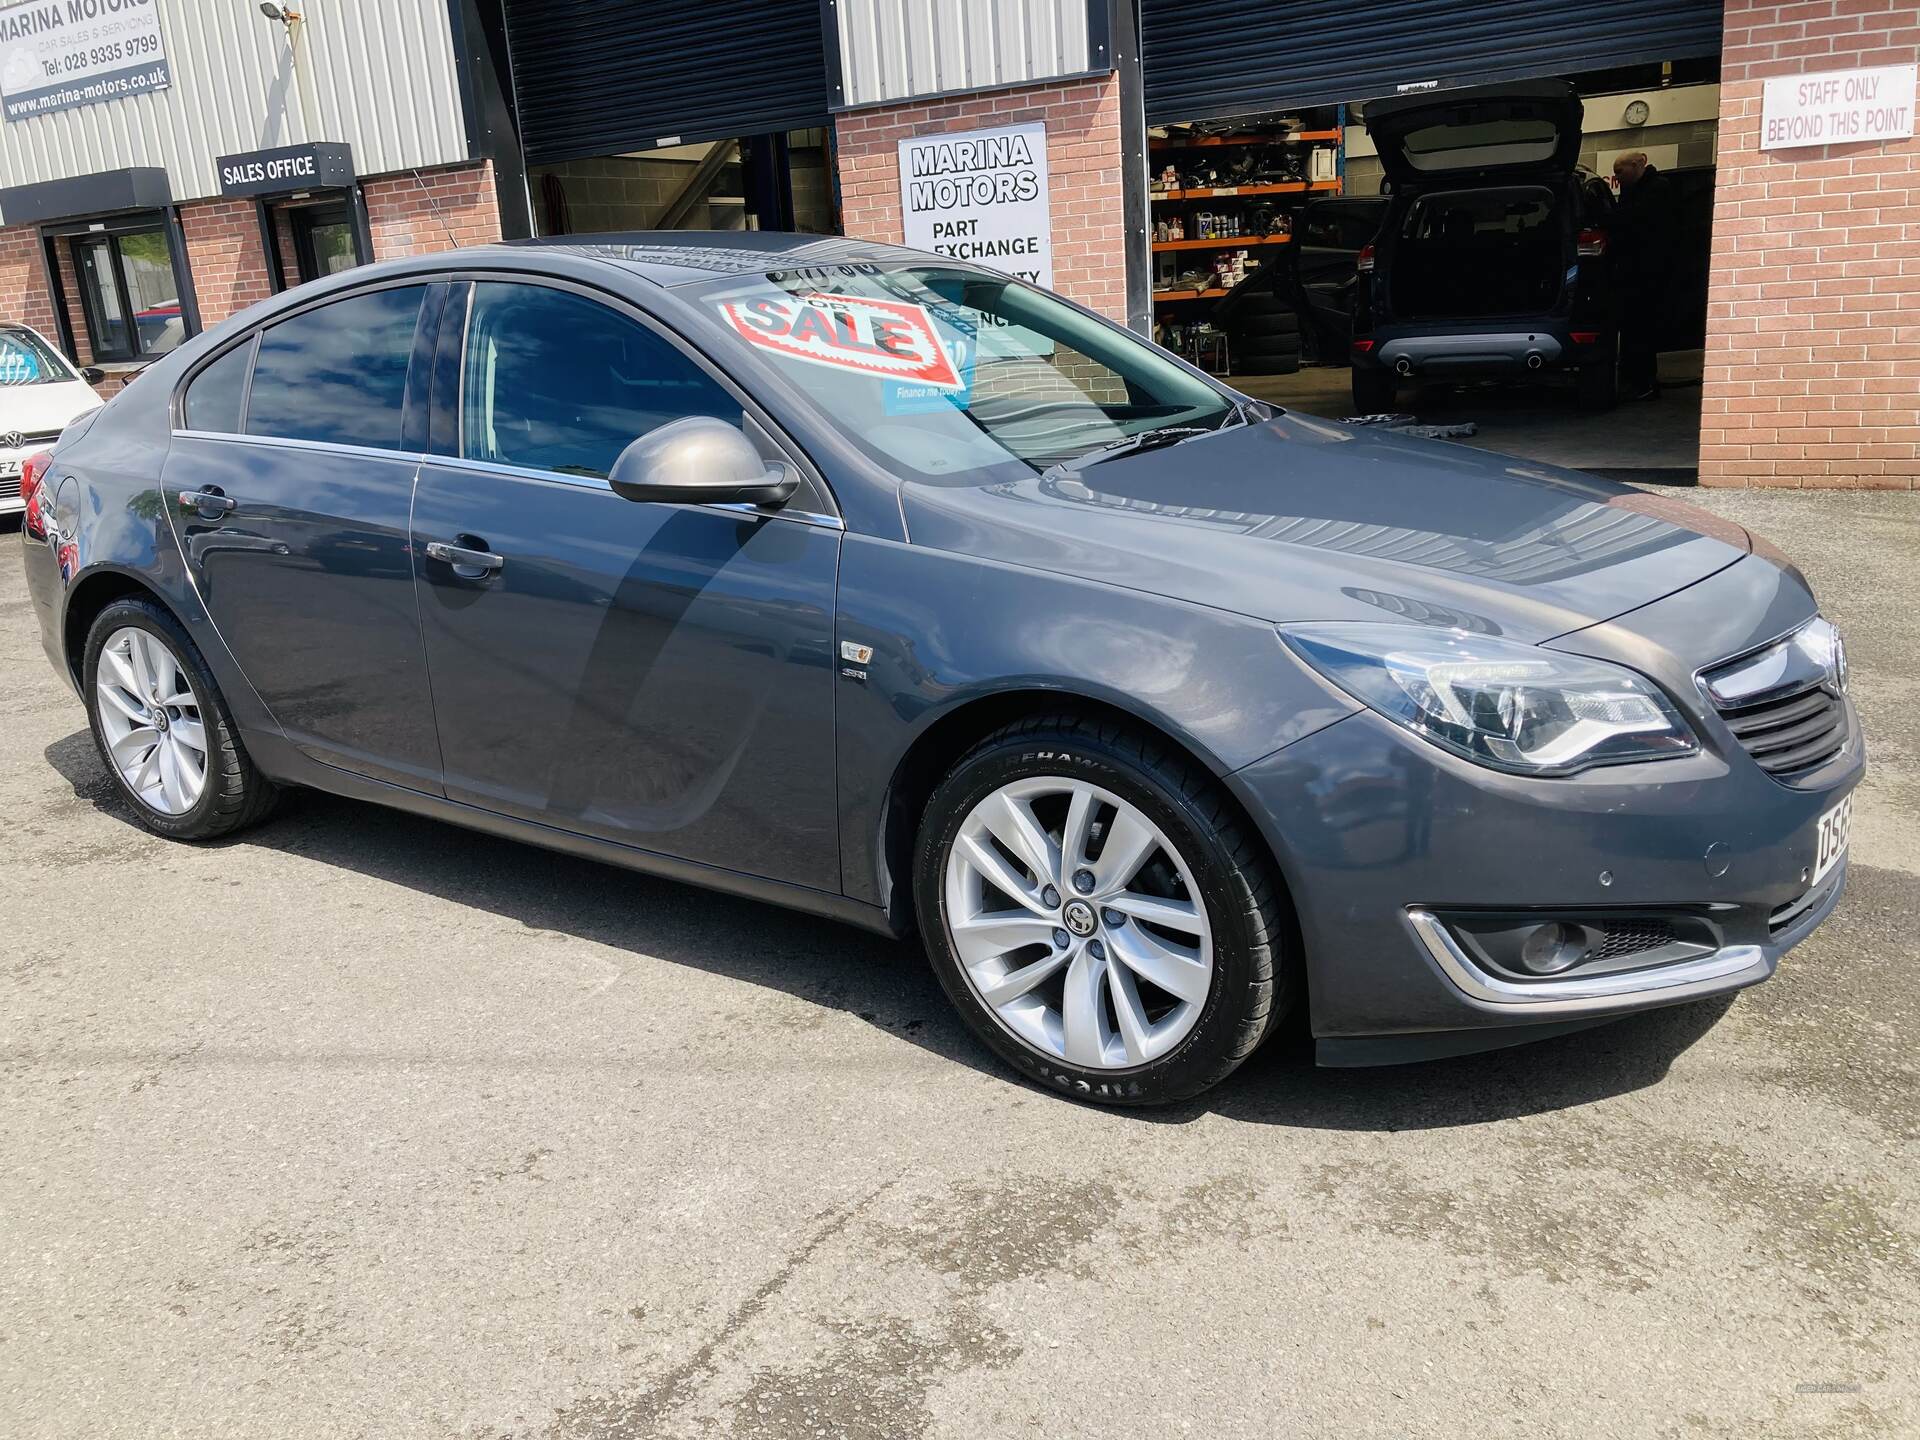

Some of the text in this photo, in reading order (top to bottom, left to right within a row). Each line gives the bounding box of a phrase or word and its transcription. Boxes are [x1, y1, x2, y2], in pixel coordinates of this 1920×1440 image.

[67, 0, 149, 24] MOTO
[39, 40, 58, 53] CAR
[60, 30, 90, 48] SALES
[42, 34, 158, 77] Tel: 028 9335 9799
[8, 66, 167, 116] www.marina-motors.co.uk
[1798, 75, 1880, 106] STAFF ONLY
[1767, 106, 1908, 142] BEYOND THIS POINT
[223, 155, 316, 185] SALES OFFICE
[910, 134, 1033, 177] MARINA
[909, 170, 1039, 212] MOTORS
[932, 219, 979, 239] PART
[934, 236, 1039, 260] EXCHANGE
[744, 297, 914, 360] SALE
[896, 386, 926, 399] Finance
